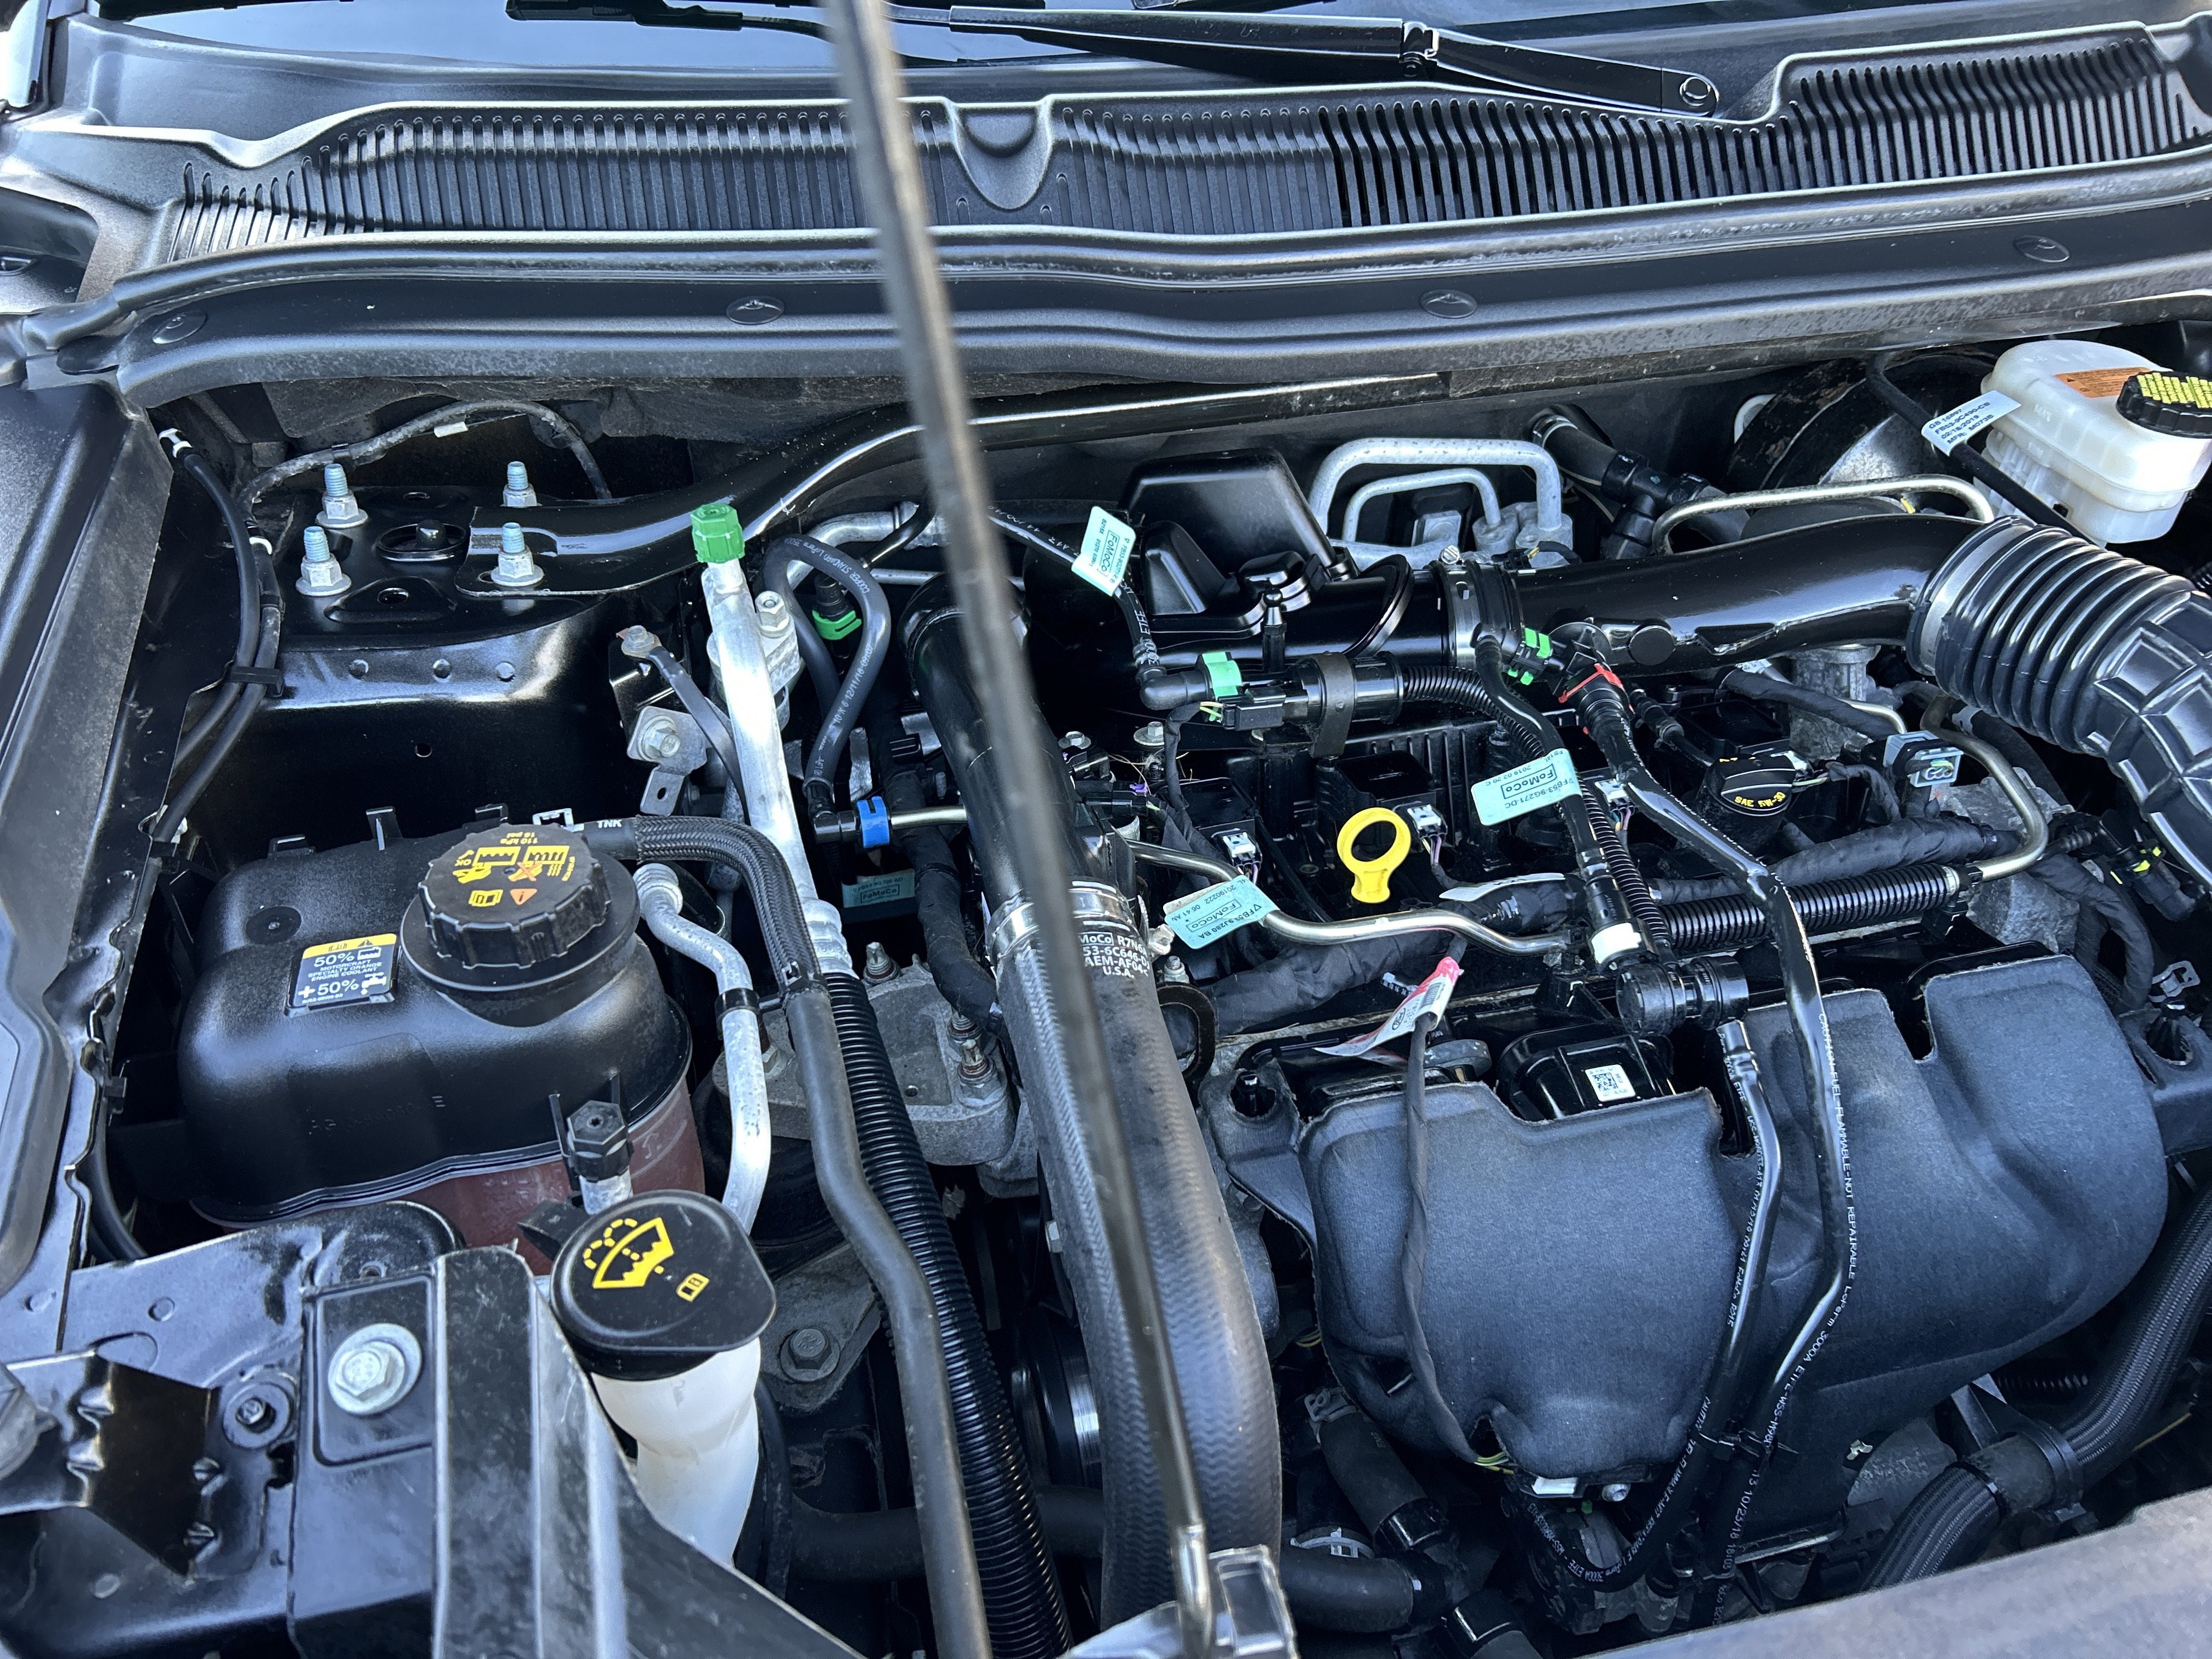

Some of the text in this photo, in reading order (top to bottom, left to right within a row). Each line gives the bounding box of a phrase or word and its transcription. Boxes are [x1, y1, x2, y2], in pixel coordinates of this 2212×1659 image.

[1101, 533, 1118, 572] FoMoCo
[1134, 610, 1150, 634] ETFE
[1513, 765, 1531, 776] 2019
[1505, 769, 1554, 793] FoMoCo
[1734, 791, 1786, 807] SAE 5W-30
[597, 819, 622, 828] TNK
[862, 888, 896, 899] FoMoCo
[1191, 902, 1235, 929] FoMoCo
[313, 952, 354, 967] 50%
[320, 960, 371, 971] MOTORCRAFT
[308, 962, 382, 978] SPECIALTY ORANGE
[341, 967, 376, 976] COOLANT
[1102, 965, 1134, 978] U.S.A.
[1847, 1206, 1857, 1280] REPAIRABLE
[1826, 1286, 1852, 1327] LoPerm
[1802, 1330, 1829, 1363] 3000A
